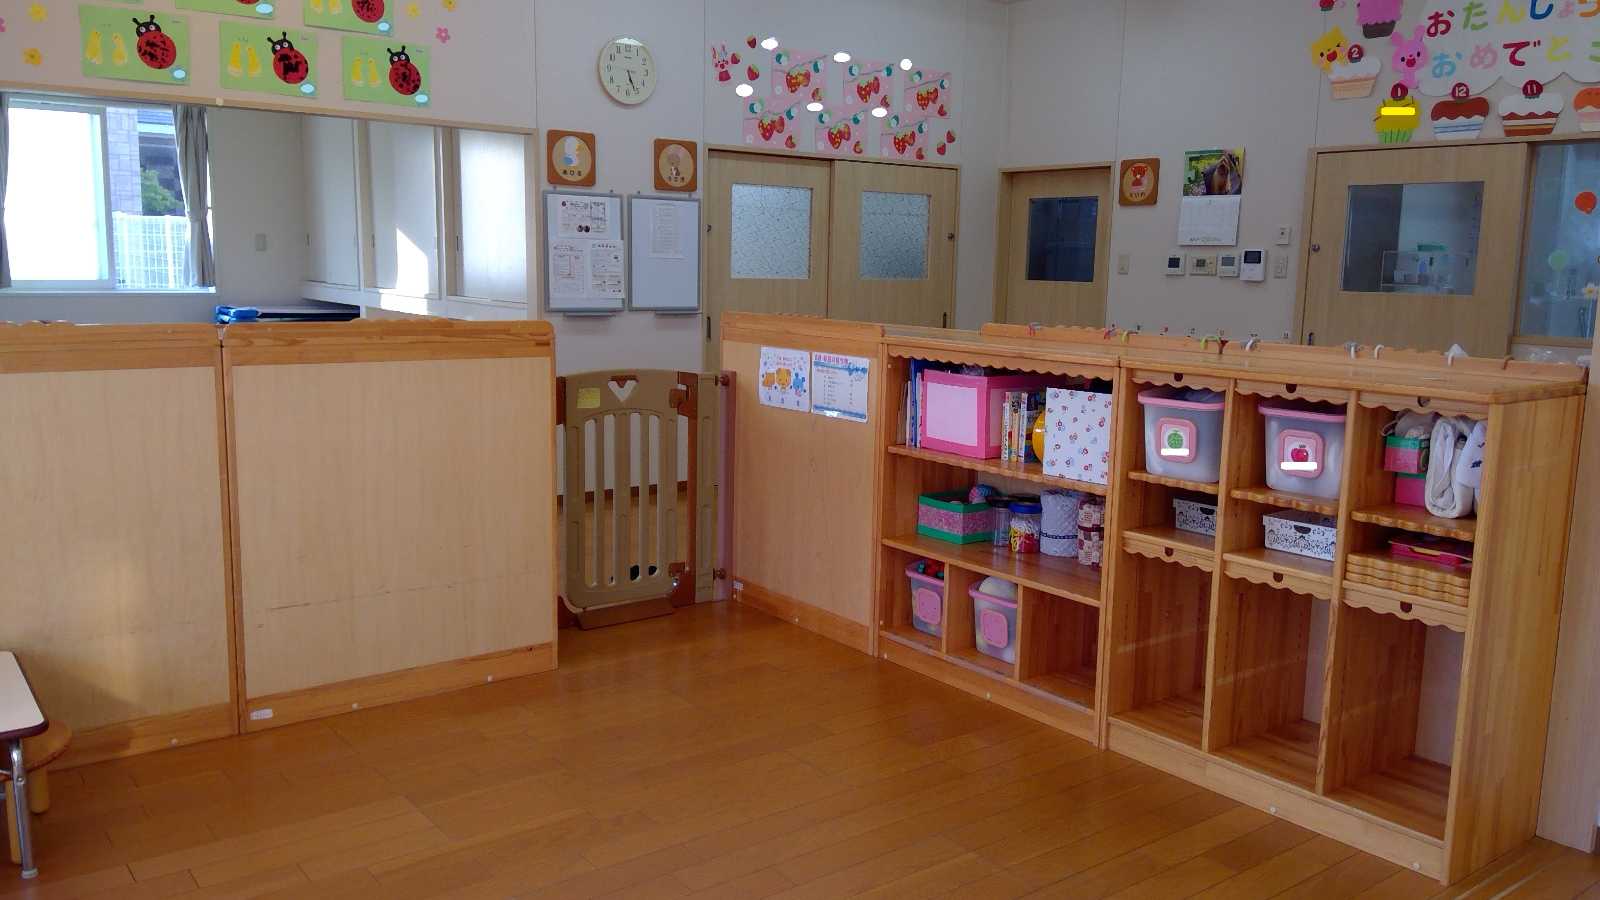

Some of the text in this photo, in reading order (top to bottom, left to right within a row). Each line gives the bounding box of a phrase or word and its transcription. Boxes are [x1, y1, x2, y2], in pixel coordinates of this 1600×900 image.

[1351, 47, 1360, 58] 2
[1455, 85, 1467, 97] 12
[1526, 83, 1537, 95] 11
